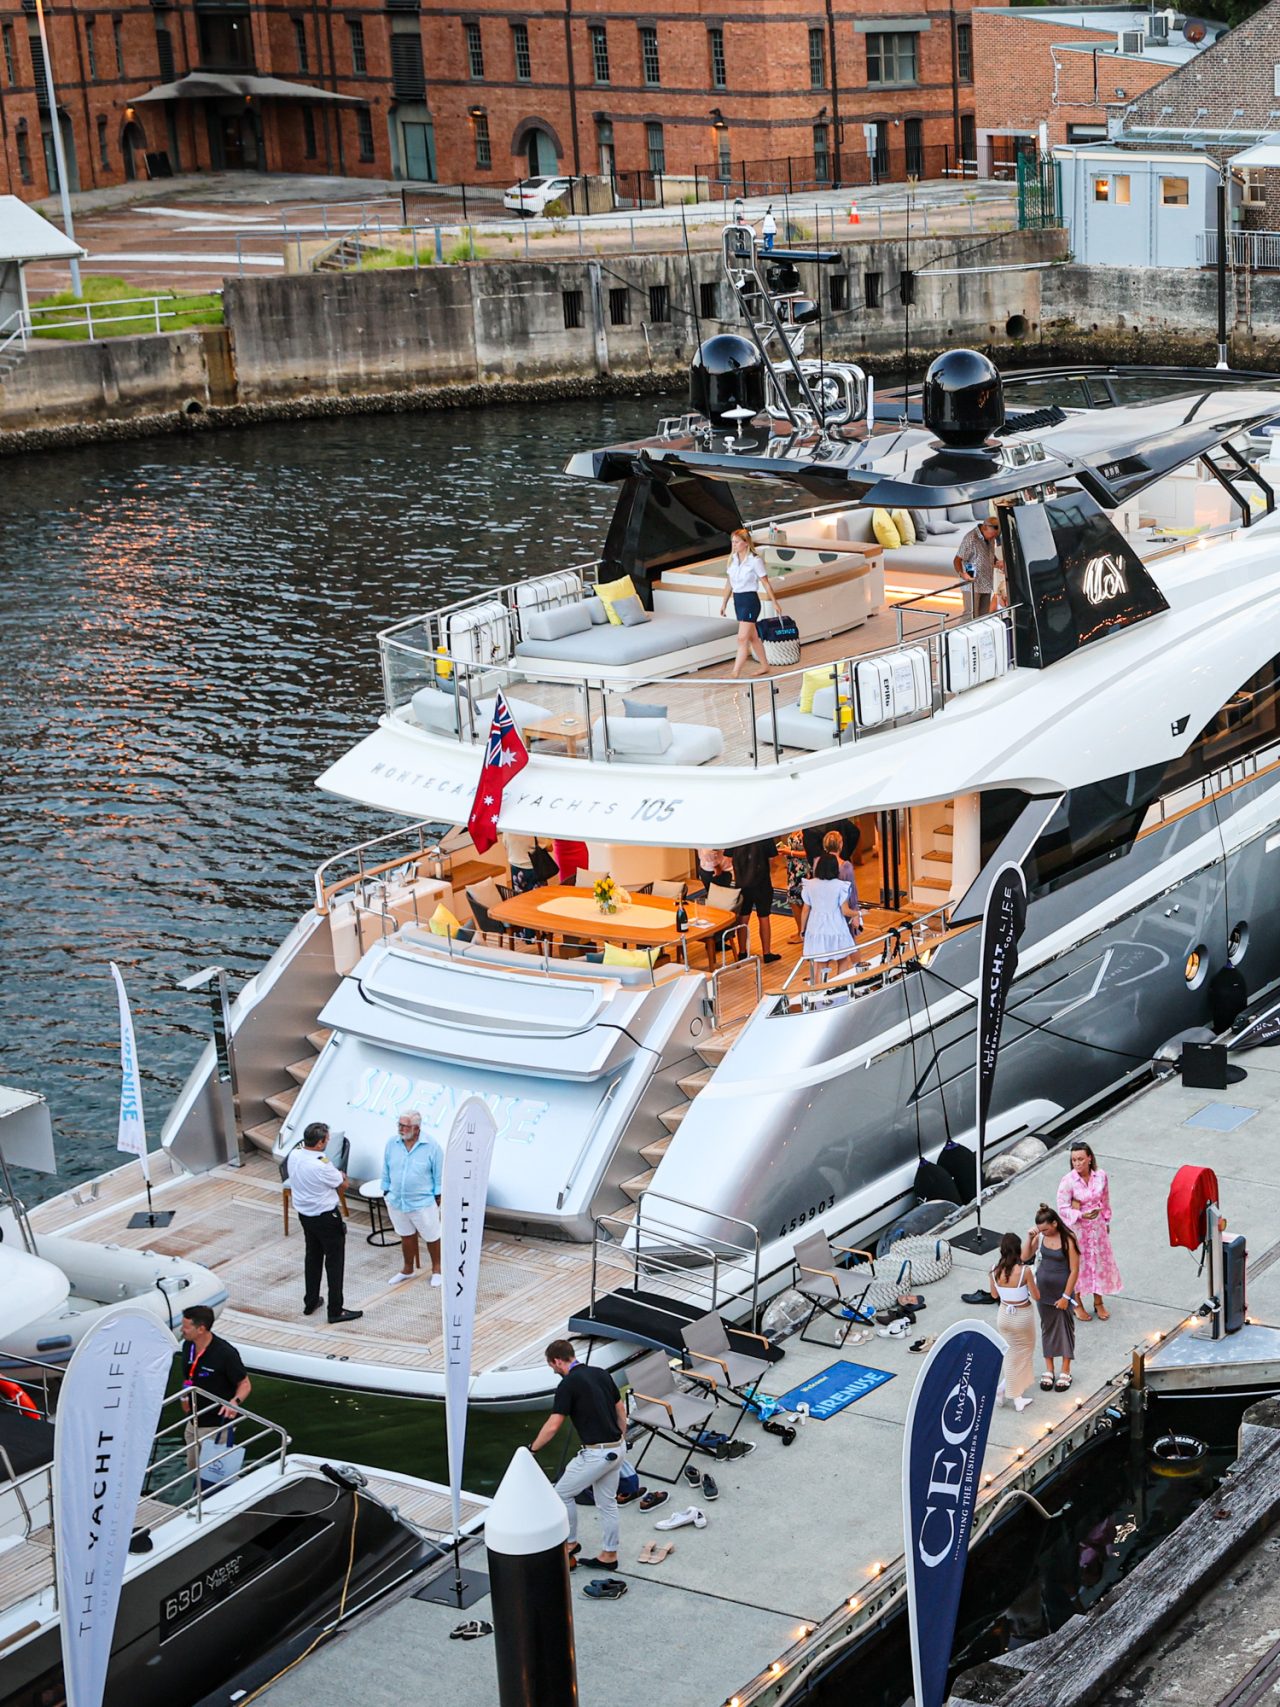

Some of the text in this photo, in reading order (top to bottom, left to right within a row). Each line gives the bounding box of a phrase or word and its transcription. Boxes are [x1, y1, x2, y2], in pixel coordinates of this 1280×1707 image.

[370, 762, 684, 823] MONTECAO YACHTS 105
[989, 943, 1004, 1019] ACHT
[1000, 886, 1013, 932] LIFE
[122, 1028, 138, 1122] IRENUSE
[450, 1121, 476, 1366] THE YACHT LIFE
[779, 1194, 836, 1238] 459903
[810, 1371, 886, 1415] SIRENUSE
[954, 1352, 975, 1423] MAGAZINE
[974, 1394, 987, 1433] WORLD
[78, 1340, 132, 1637] THE YACHT LIFE
[919, 1381, 977, 1568] CEO
[965, 1435, 980, 1484] BUSINESS
[962, 1485, 973, 1507] THE
[165, 1580, 204, 1620] 630
